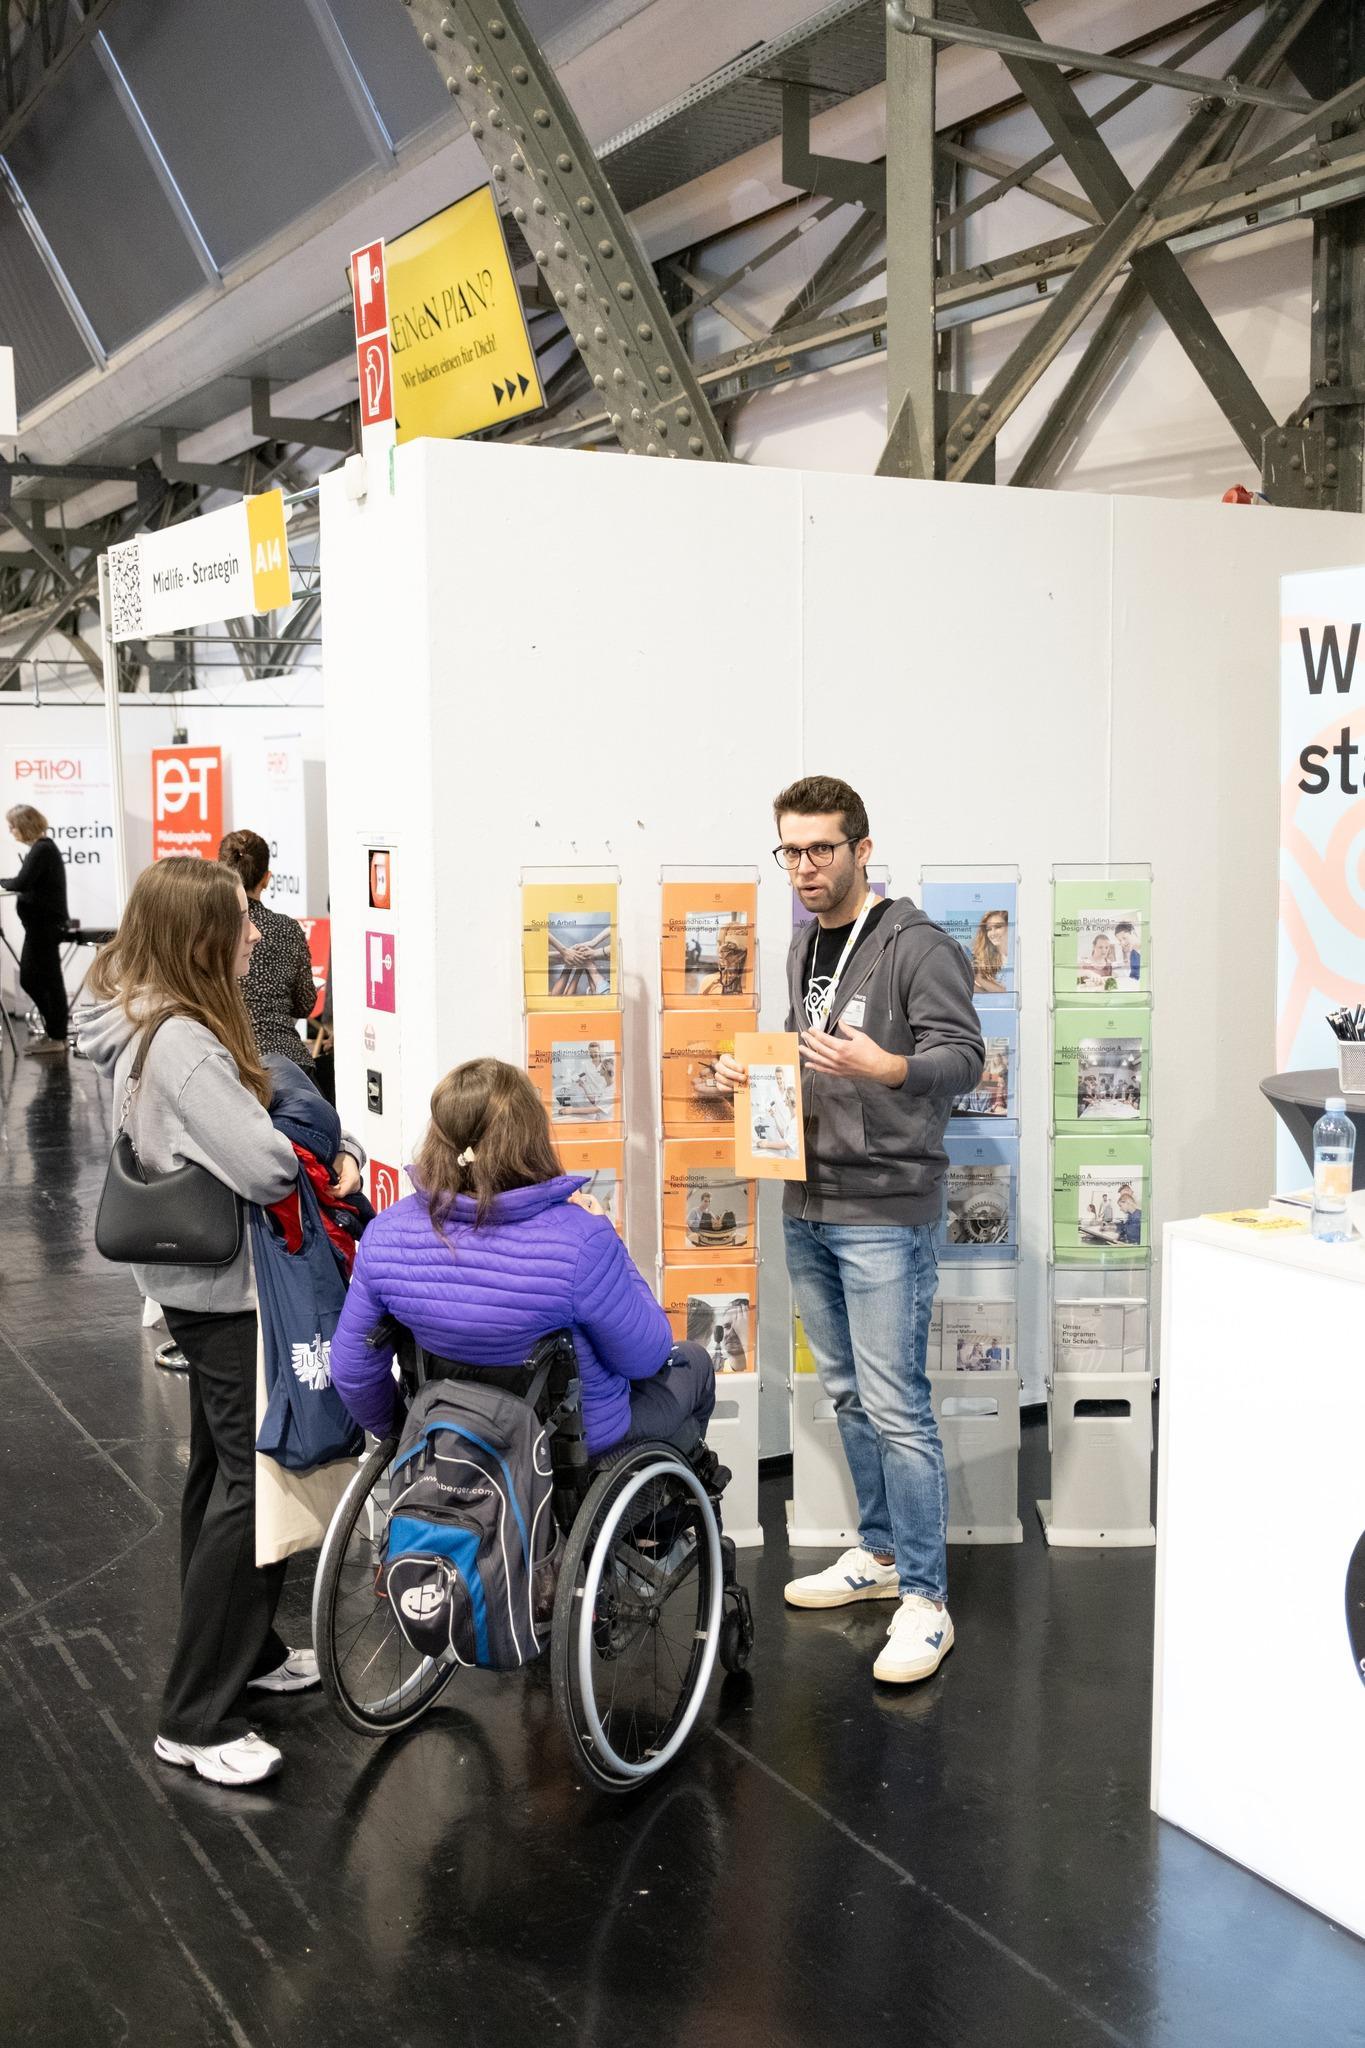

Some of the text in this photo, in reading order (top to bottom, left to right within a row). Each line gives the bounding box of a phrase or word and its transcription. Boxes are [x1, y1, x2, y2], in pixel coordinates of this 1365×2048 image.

[401, 333, 497, 389] Wir haben einen für Dich!
[153, 567, 184, 594] Midlife
[192, 553, 239, 584] Strategin
[255, 537, 282, 575] A14
[1298, 727, 1365, 795] st
[1061, 924, 1085, 932] Design
